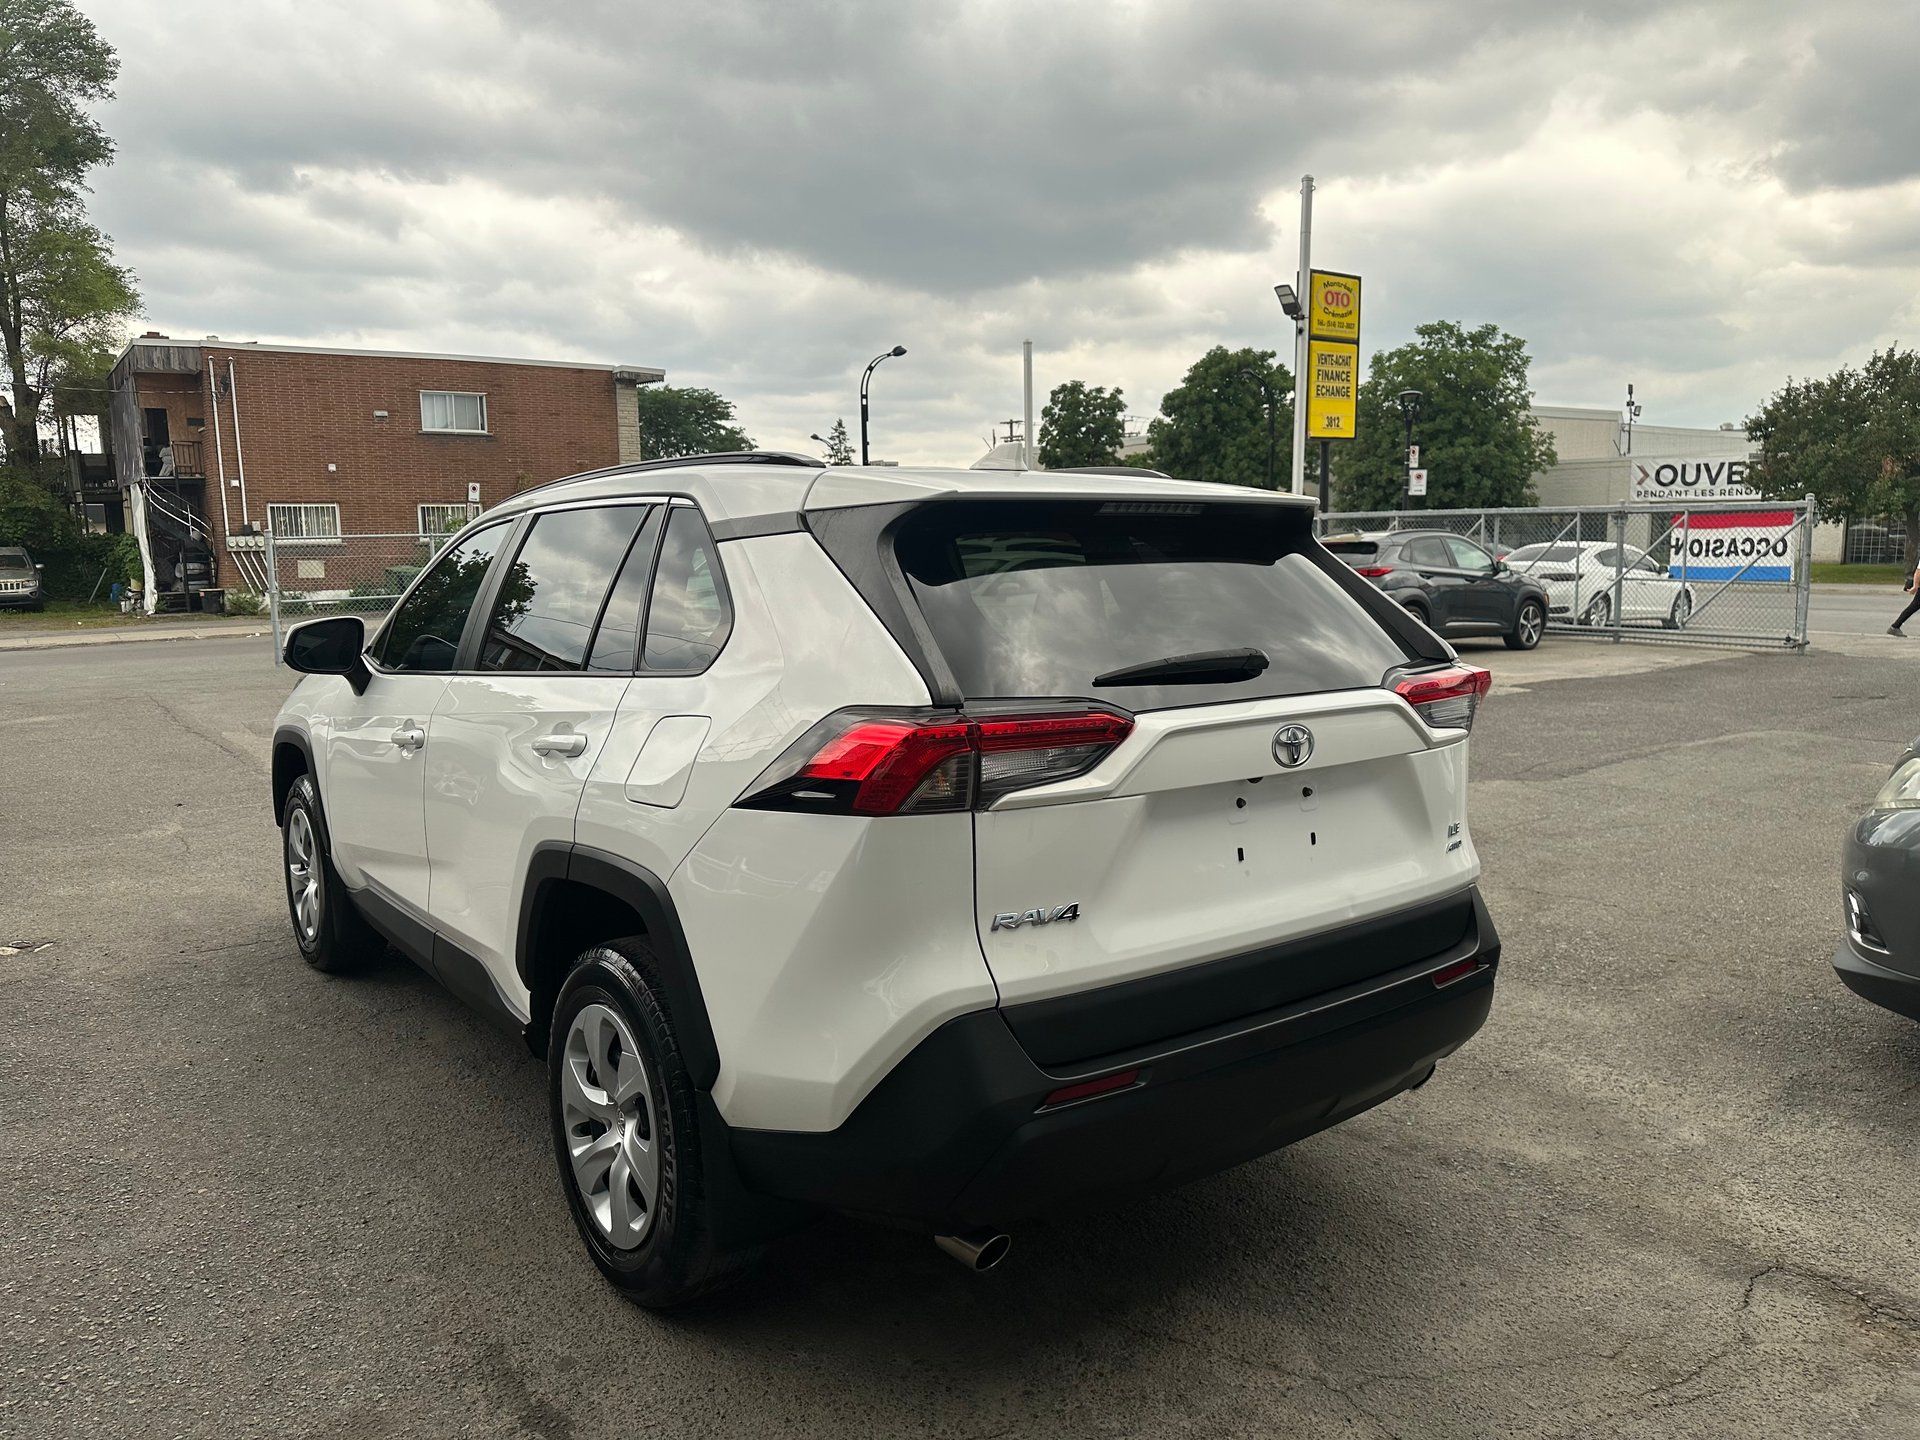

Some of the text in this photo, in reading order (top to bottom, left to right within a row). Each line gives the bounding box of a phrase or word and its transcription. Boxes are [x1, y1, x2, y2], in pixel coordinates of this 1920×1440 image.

[1325, 290, 1350, 307] OTO
[1323, 306, 1353, 318] Crémazie
[1316, 353, 1352, 367] VENTE-ACHAT
[1317, 369, 1351, 382] FINANCE
[1316, 385, 1350, 398] ECHANGE
[1326, 416, 1340, 428] 3812
[1655, 461, 1747, 487] OUVE
[1636, 486, 1761, 498] PENDANT LES RÉNOV
[991, 901, 1080, 932] RAV4
